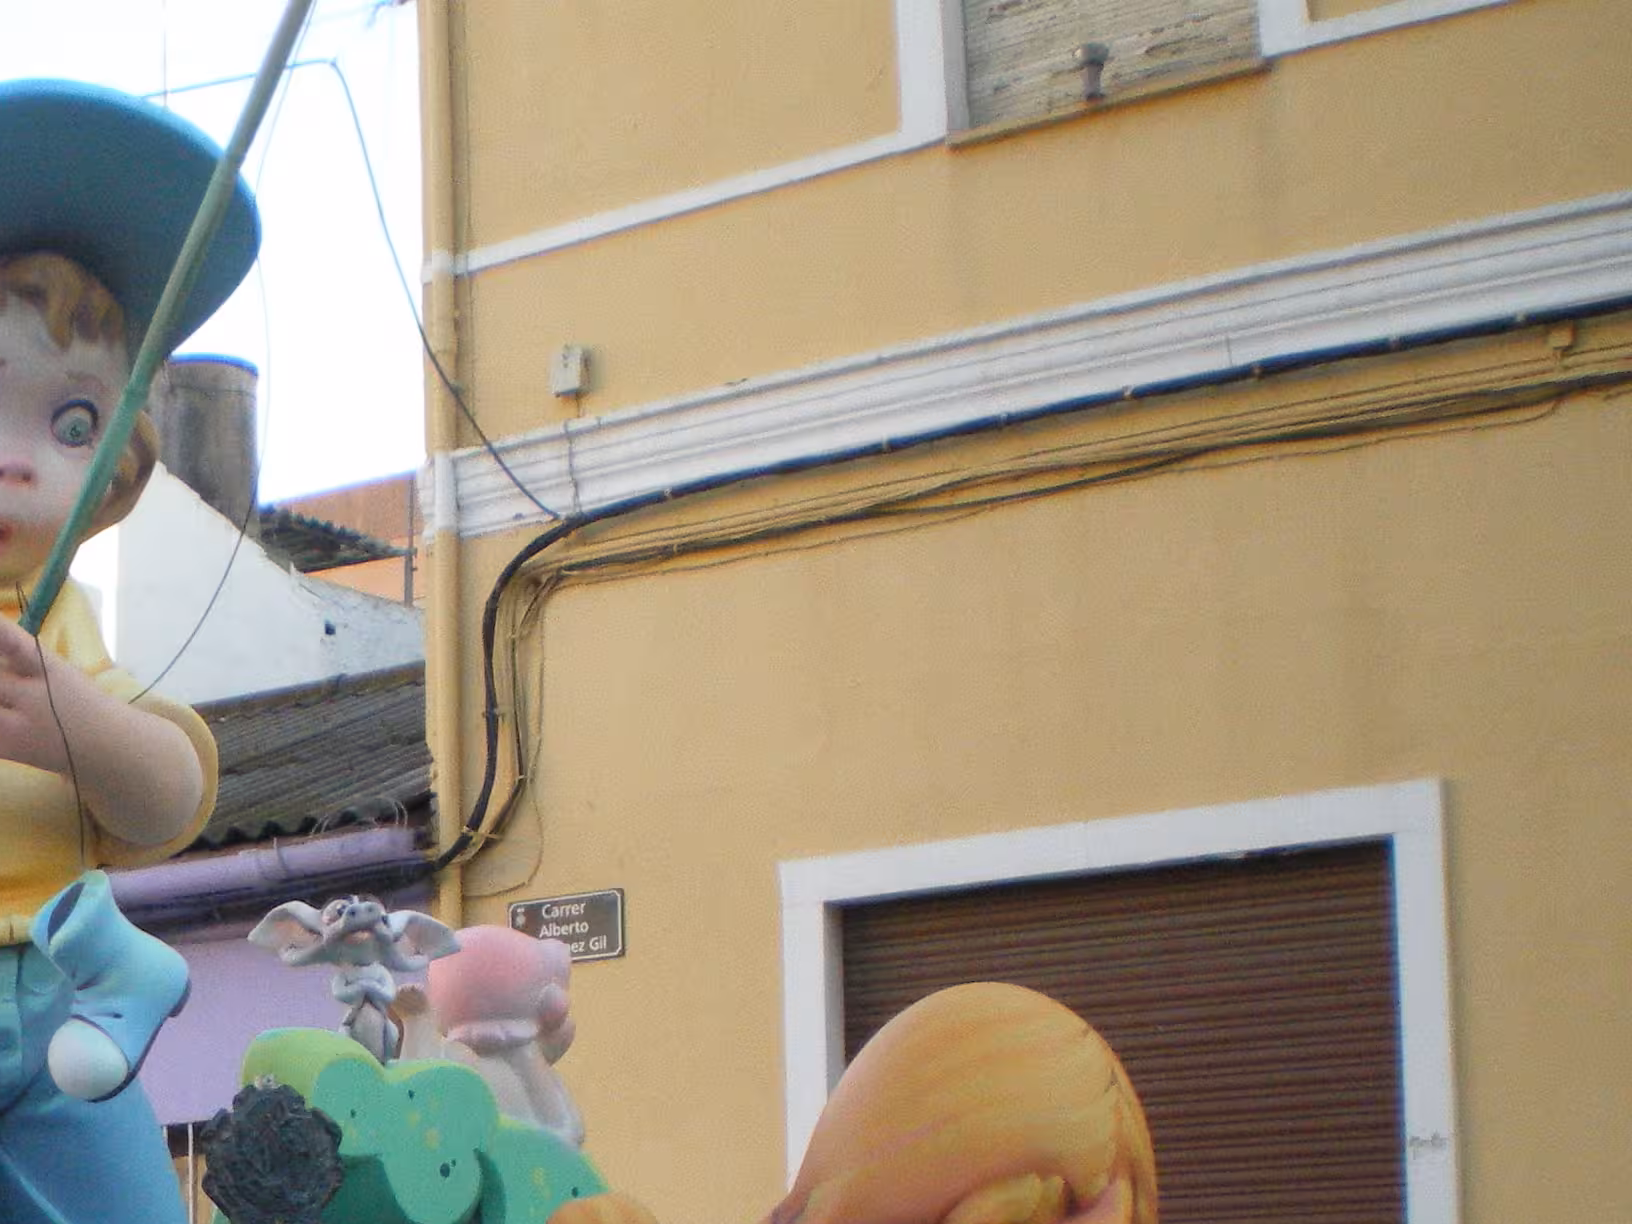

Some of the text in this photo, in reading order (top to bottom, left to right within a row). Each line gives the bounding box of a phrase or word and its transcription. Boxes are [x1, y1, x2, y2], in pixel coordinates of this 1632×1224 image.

[542, 902, 586, 919] Carrer
[539, 921, 590, 938] Alberto
[589, 935, 607, 951] Gil
